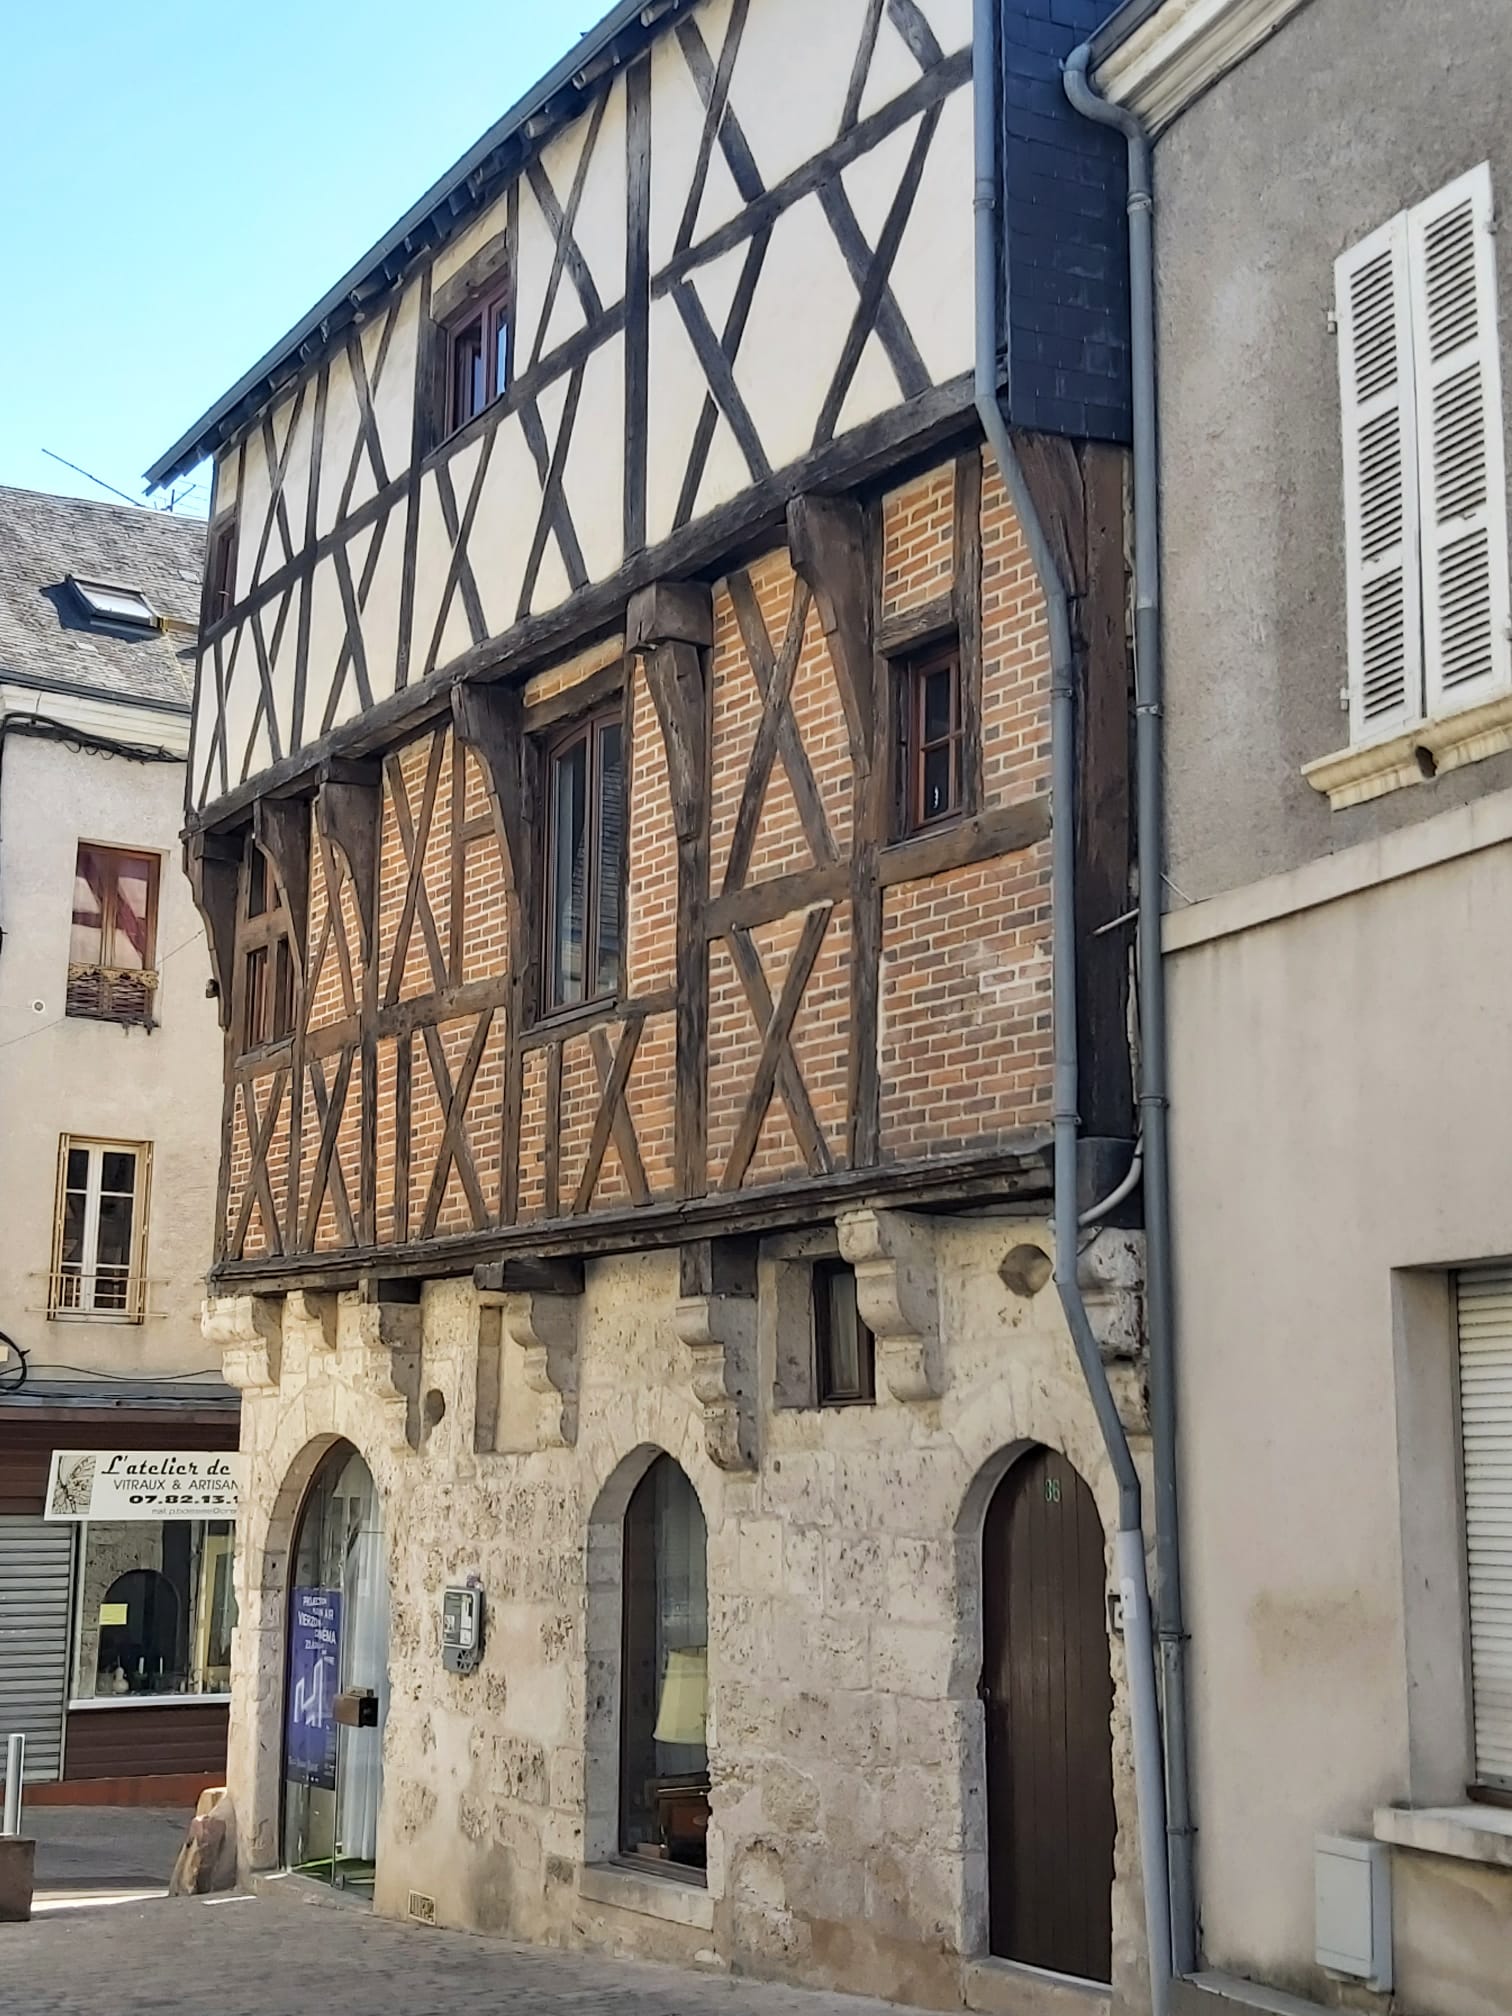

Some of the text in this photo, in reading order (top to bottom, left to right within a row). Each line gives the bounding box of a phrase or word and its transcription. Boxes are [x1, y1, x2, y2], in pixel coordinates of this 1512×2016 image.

[101, 1455, 231, 1475] L'atelier de
[113, 1479, 166, 1490] VITRAUX
[171, 1479, 181, 1490] &
